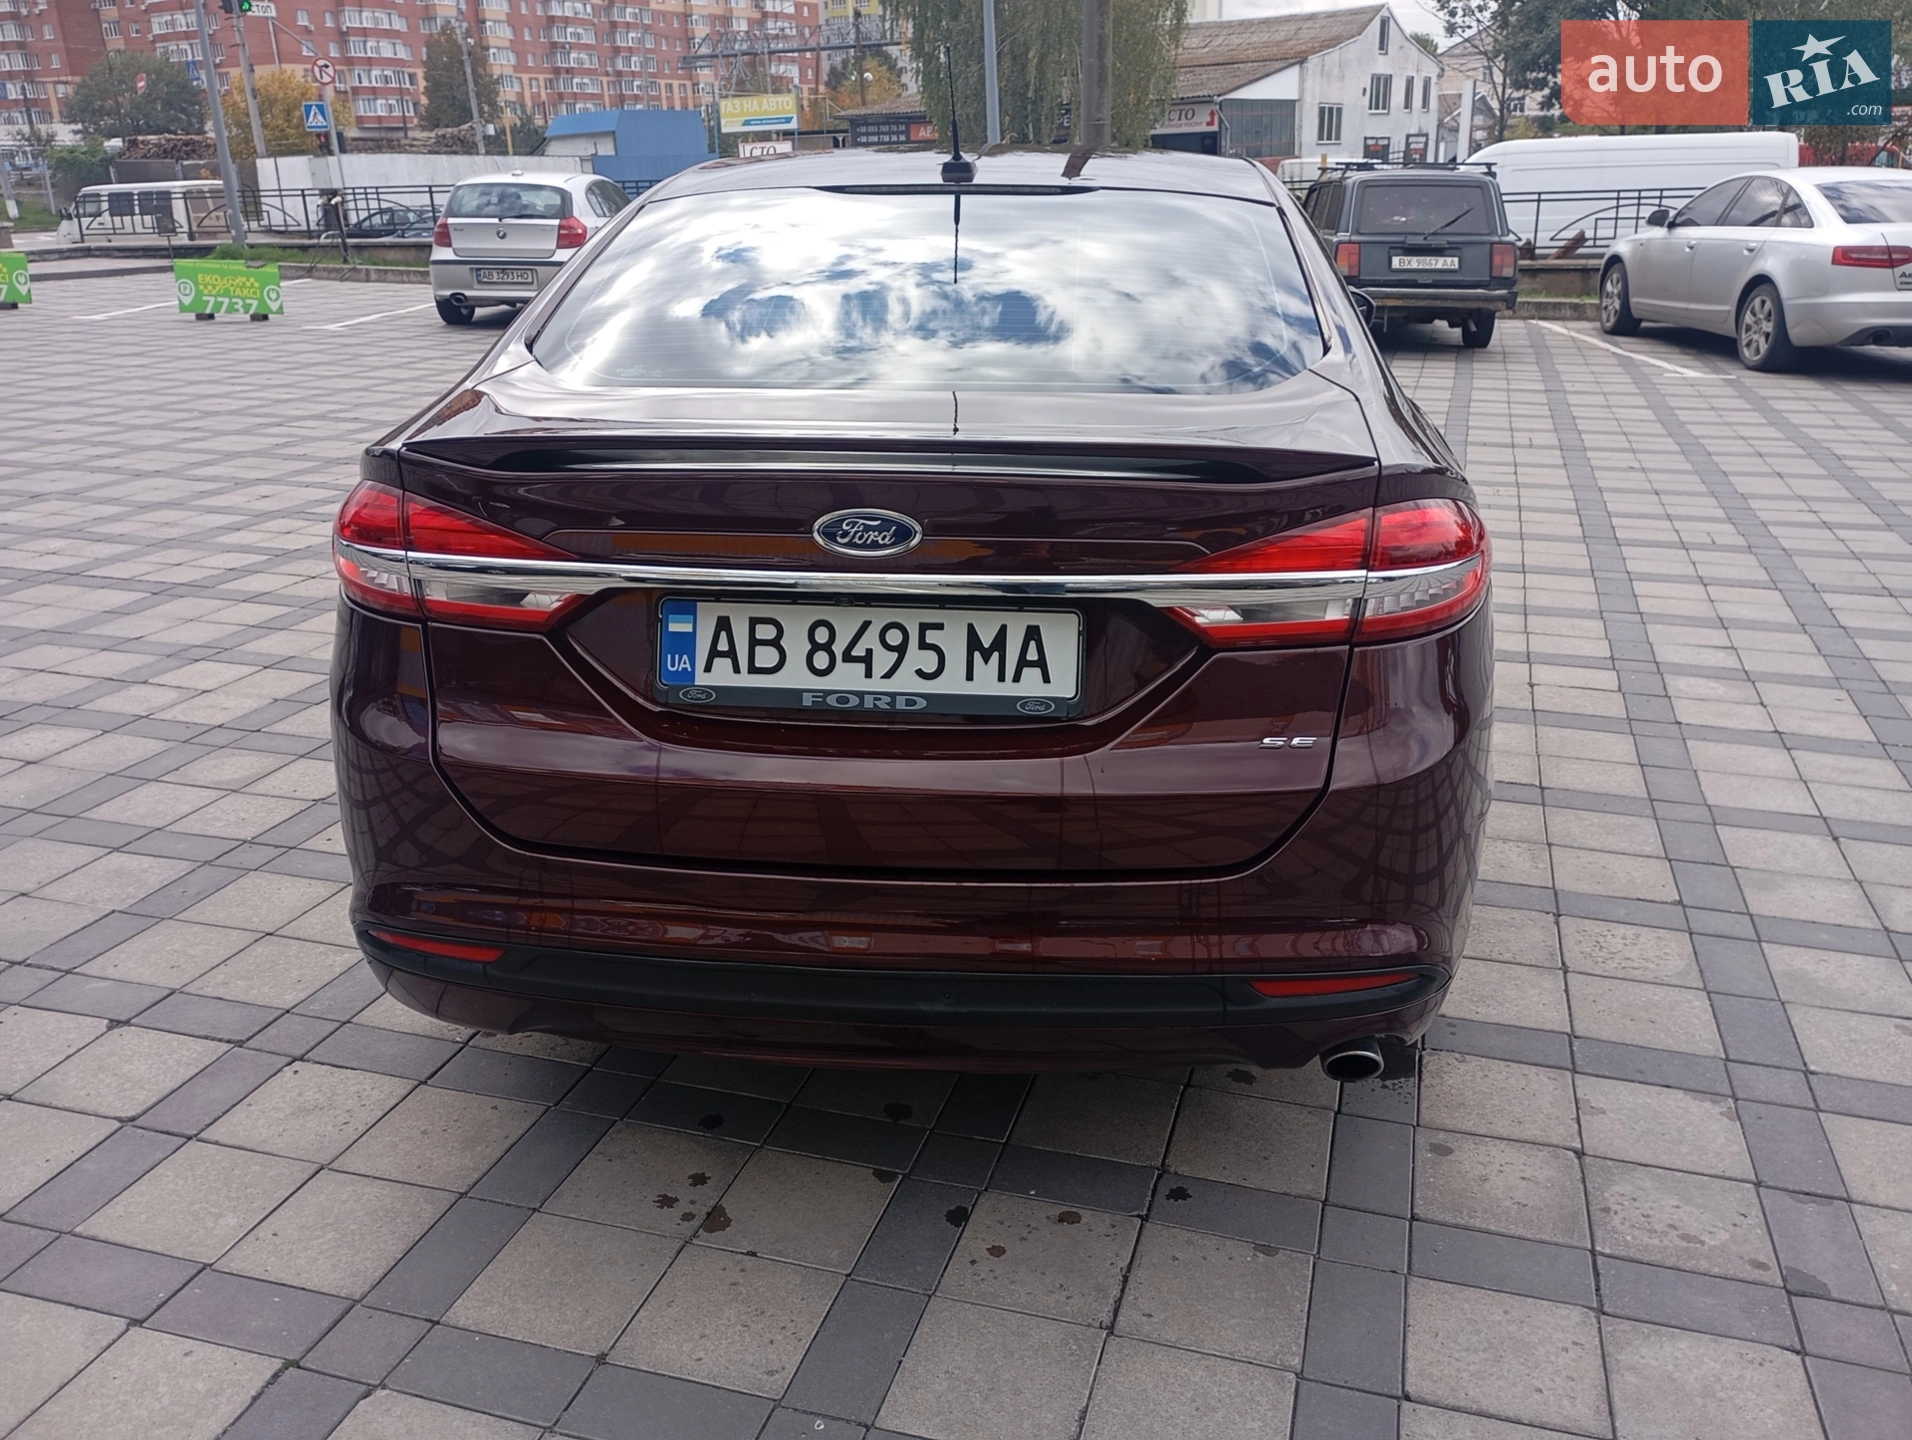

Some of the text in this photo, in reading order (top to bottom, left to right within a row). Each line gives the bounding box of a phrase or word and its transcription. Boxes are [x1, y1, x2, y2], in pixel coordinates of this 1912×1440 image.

[721, 97, 792, 114] ГАЗ НА АВТО
[1168, 107, 1195, 121] СТО
[750, 145, 777, 157] СТО
[1398, 258, 1457, 268] BX 9867 AA
[198, 273, 220, 285] ЕКО
[482, 271, 529, 280] AB 3293 HO
[229, 287, 260, 298] ТАКСІ
[202, 296, 258, 314] 7737
[836, 518, 897, 544] Ford
[703, 615, 1052, 684] AB 8495 MA
[667, 654, 692, 672] UA
[687, 689, 708, 699] Ford
[802, 692, 928, 710] FORD
[1025, 701, 1046, 711] Ford
[1258, 736, 1318, 749] SE
